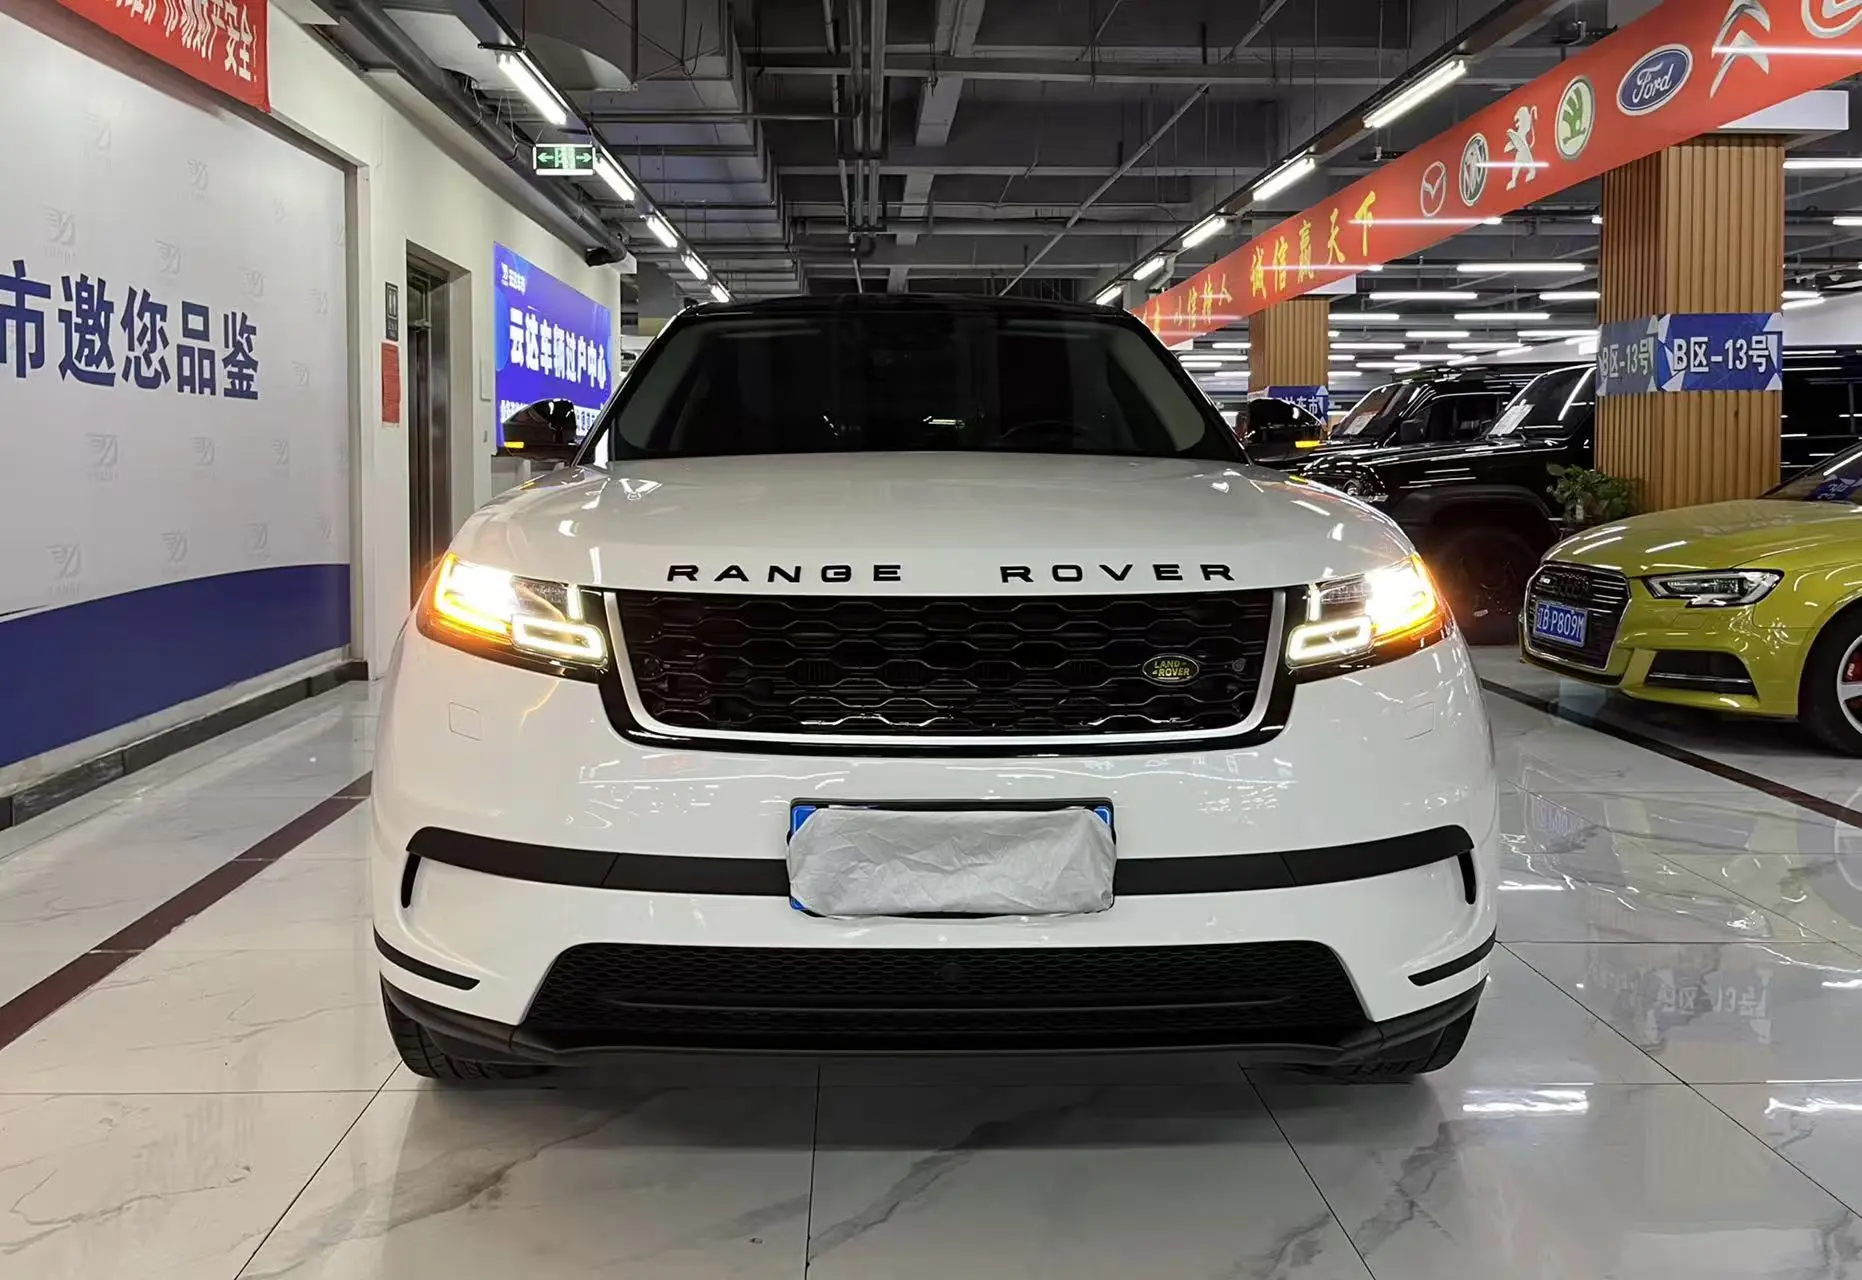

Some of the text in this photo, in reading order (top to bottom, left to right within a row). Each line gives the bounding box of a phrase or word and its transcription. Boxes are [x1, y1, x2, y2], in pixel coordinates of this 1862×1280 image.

[1632, 61, 1673, 104] Ford
[0, 260, 259, 400] 市邀您品鉴
[1602, 339, 1650, 377] B区-13号
[1673, 335, 1769, 373] B区-13号
[667, 563, 1236, 582] RANGE ROVER
[1154, 660, 1181, 669] LAND
[1158, 667, 1190, 677] ROVER
